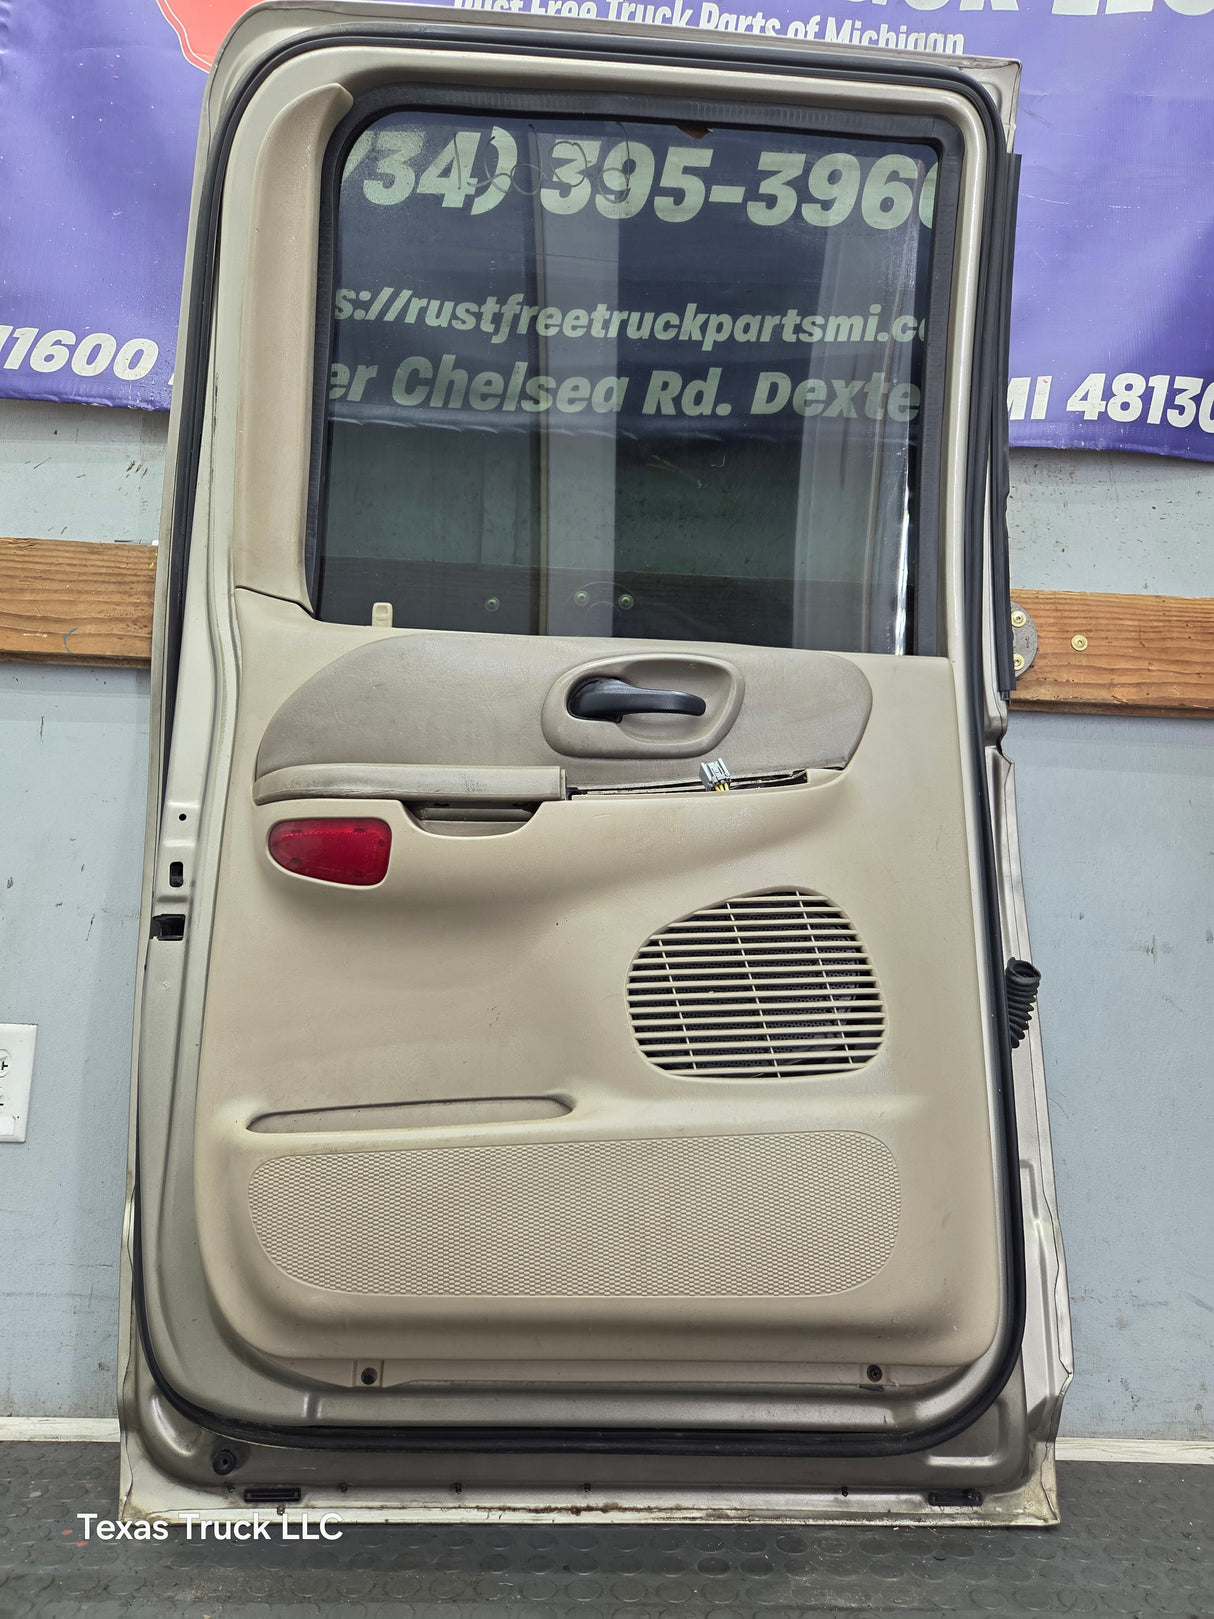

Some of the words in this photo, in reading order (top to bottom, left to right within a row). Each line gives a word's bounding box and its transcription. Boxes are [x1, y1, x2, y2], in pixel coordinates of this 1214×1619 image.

[699, 2, 781, 37] Parts
[787, 15, 821, 40] of
[392, 354, 630, 415] Chelsea
[642, 367, 732, 416] Rd.
[750, 371, 921, 422] Dexte
